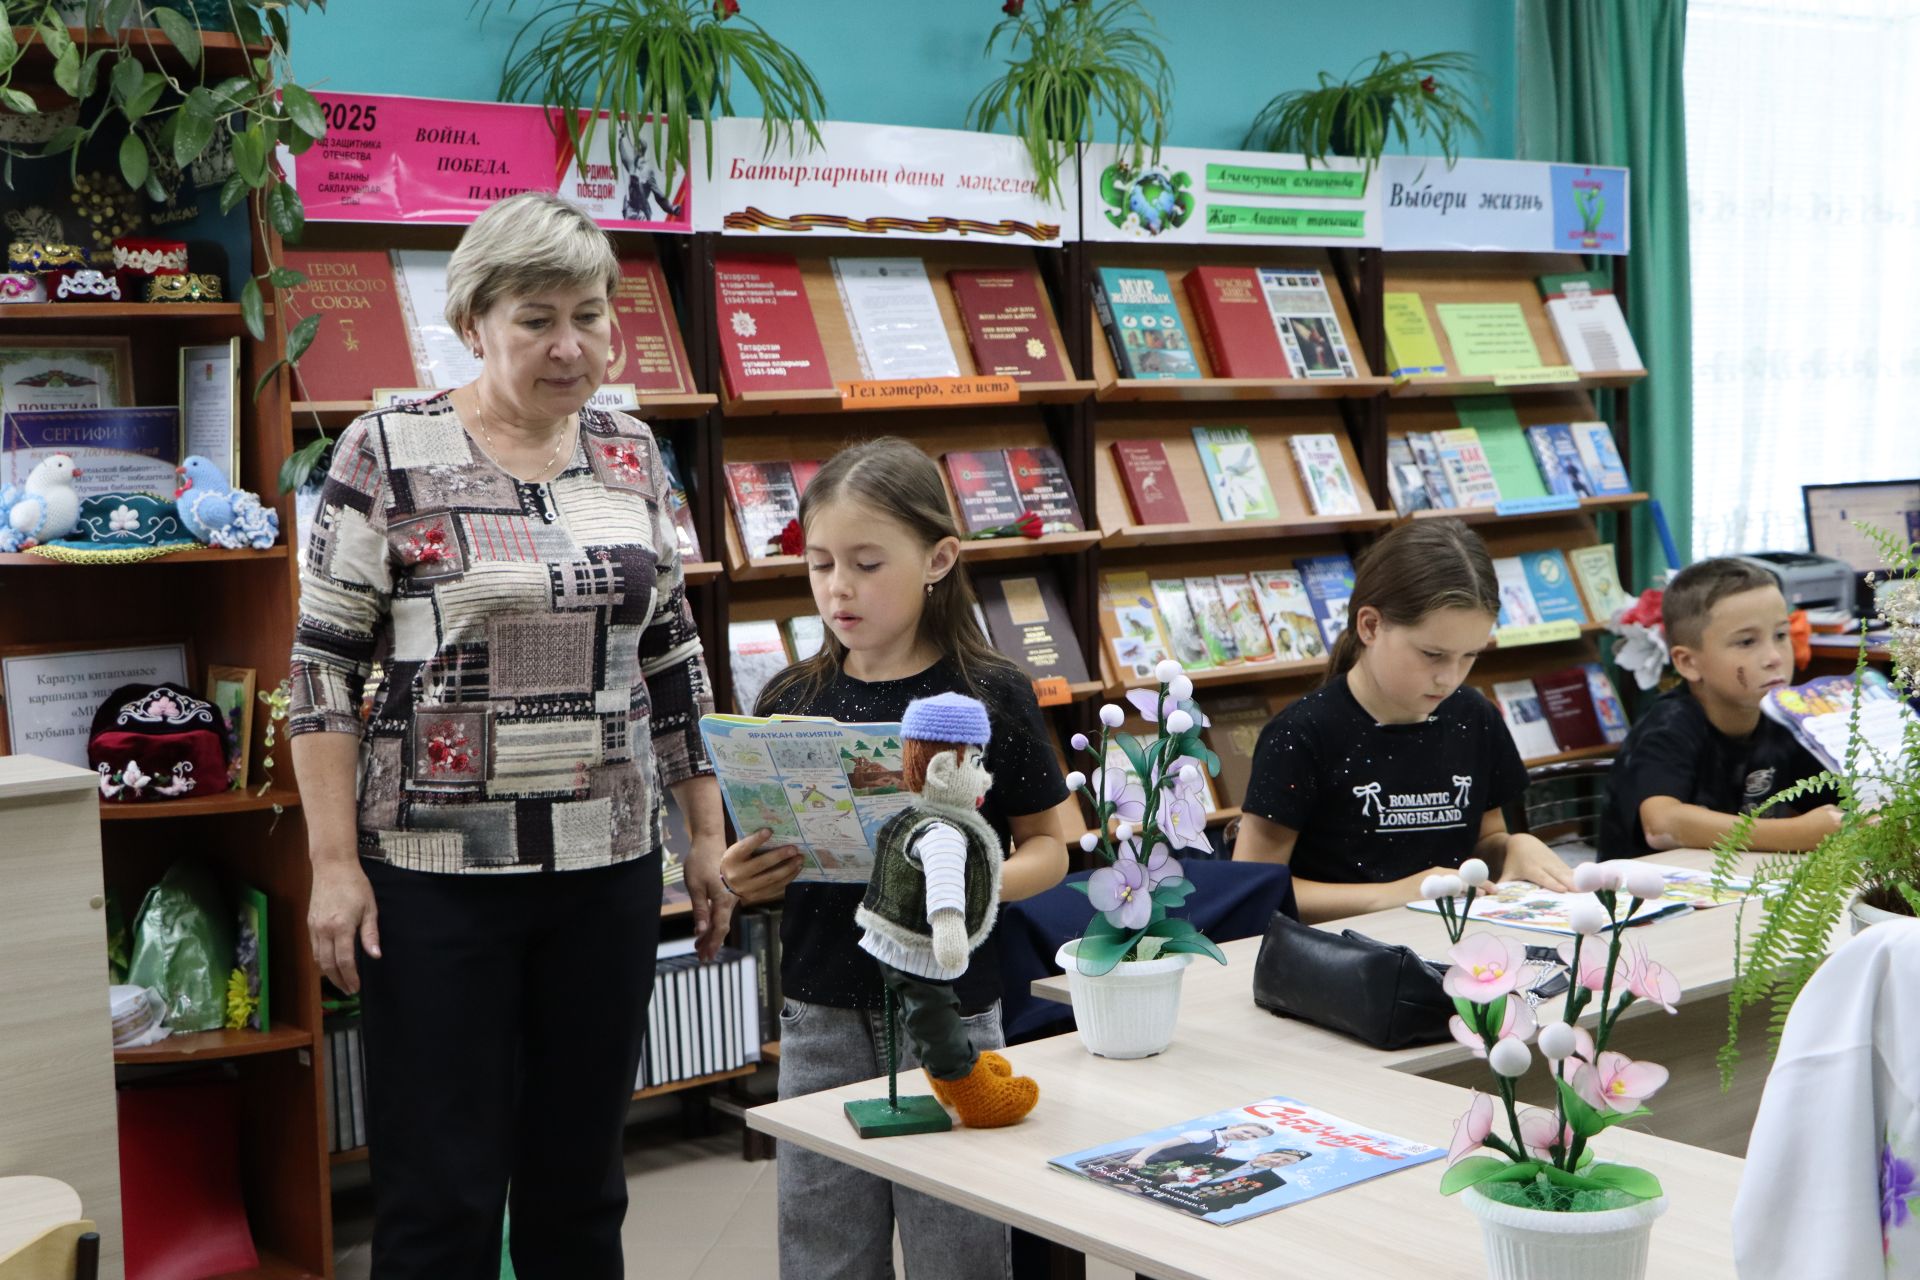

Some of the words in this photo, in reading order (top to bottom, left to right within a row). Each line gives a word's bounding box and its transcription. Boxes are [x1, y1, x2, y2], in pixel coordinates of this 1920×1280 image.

[320, 102, 376, 131] 2025
[415, 126, 480, 145] ВОЙНА.
[330, 139, 382, 149] ЗАЩИТНИКА
[323, 150, 372, 160] ОТЕЧЕСТВА
[437, 157, 510, 174] ПОБЕДА.
[729, 158, 888, 187] Батырларның
[895, 164, 945, 187] даны
[577, 183, 615, 200] ПОБЕДОЙ!
[1390, 182, 1467, 215] Выбери
[1479, 190, 1543, 211] жизнь
[307, 263, 358, 276] ГЕРОИ
[293, 279, 387, 292] ОВЕТСКОГО
[311, 295, 371, 309] СОЮЗА
[850, 384, 875, 398] Гел
[880, 382, 944, 399] хәтердә,
[950, 383, 971, 394] гел
[976, 382, 1010, 393] истә
[590, 391, 624, 406] ойны
[42, 426, 148, 442] СЕРТИФИКАТ
[37, 674, 84, 687] Каратун
[29, 690, 88, 705] каршында
[25, 726, 75, 741] клубына
[747, 731, 793, 739] ЯРАТКАН
[1388, 792, 1450, 807] ROMANTIC
